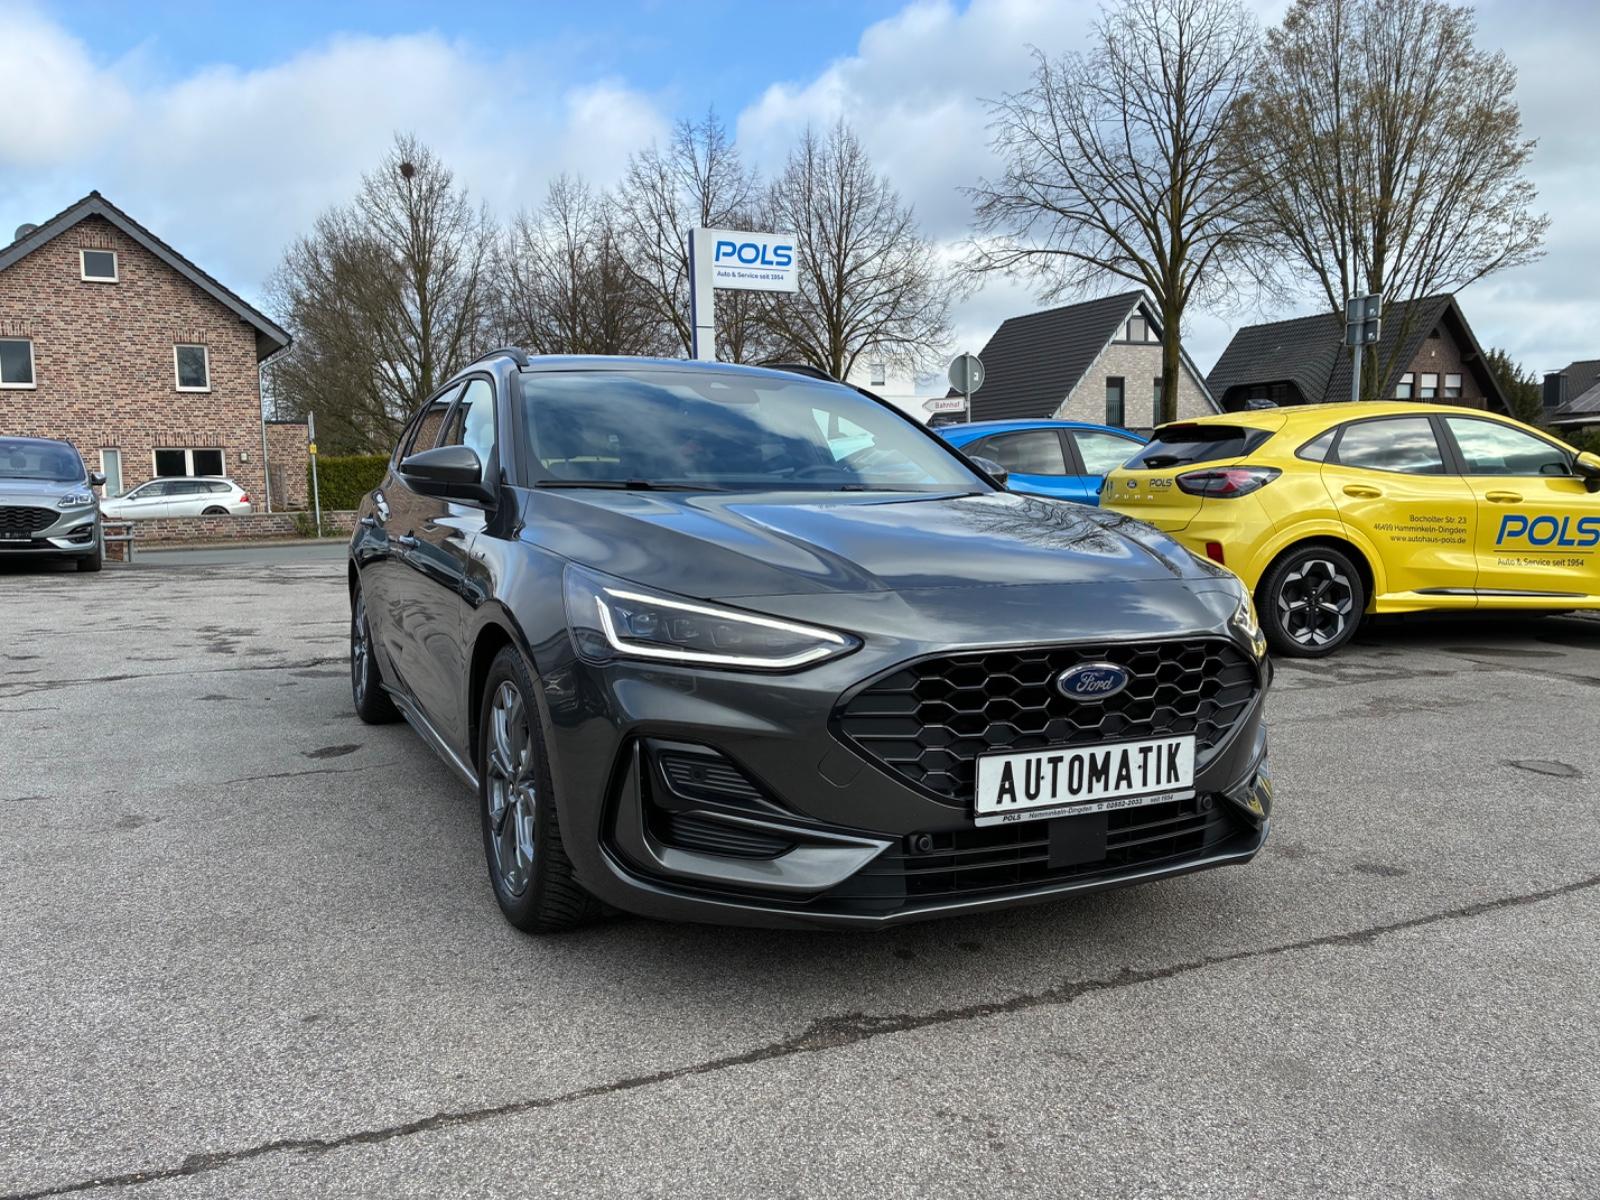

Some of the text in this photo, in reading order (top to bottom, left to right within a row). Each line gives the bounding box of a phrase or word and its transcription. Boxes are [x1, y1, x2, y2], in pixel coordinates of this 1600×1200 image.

[715, 241, 793, 267] POLS
[935, 401, 960, 409] Bahnhof
[1149, 479, 1173, 487] POLS
[1409, 515, 1467, 524] Bocholter Str. 23
[1374, 523, 1467, 535] 46499 Hamminkeln-Dingden
[1496, 515, 1600, 546] POLS
[1390, 535, 1467, 545] www.autohaus-pols.de
[1498, 558, 1515, 566] Auto
[1523, 558, 1551, 567] Service
[1552, 559, 1565, 567] seit
[1567, 559, 1584, 567] 1954
[1076, 671, 1114, 692] Ford
[996, 742, 1181, 805] AUTOMATIK
[1003, 814, 1021, 822] POLS
